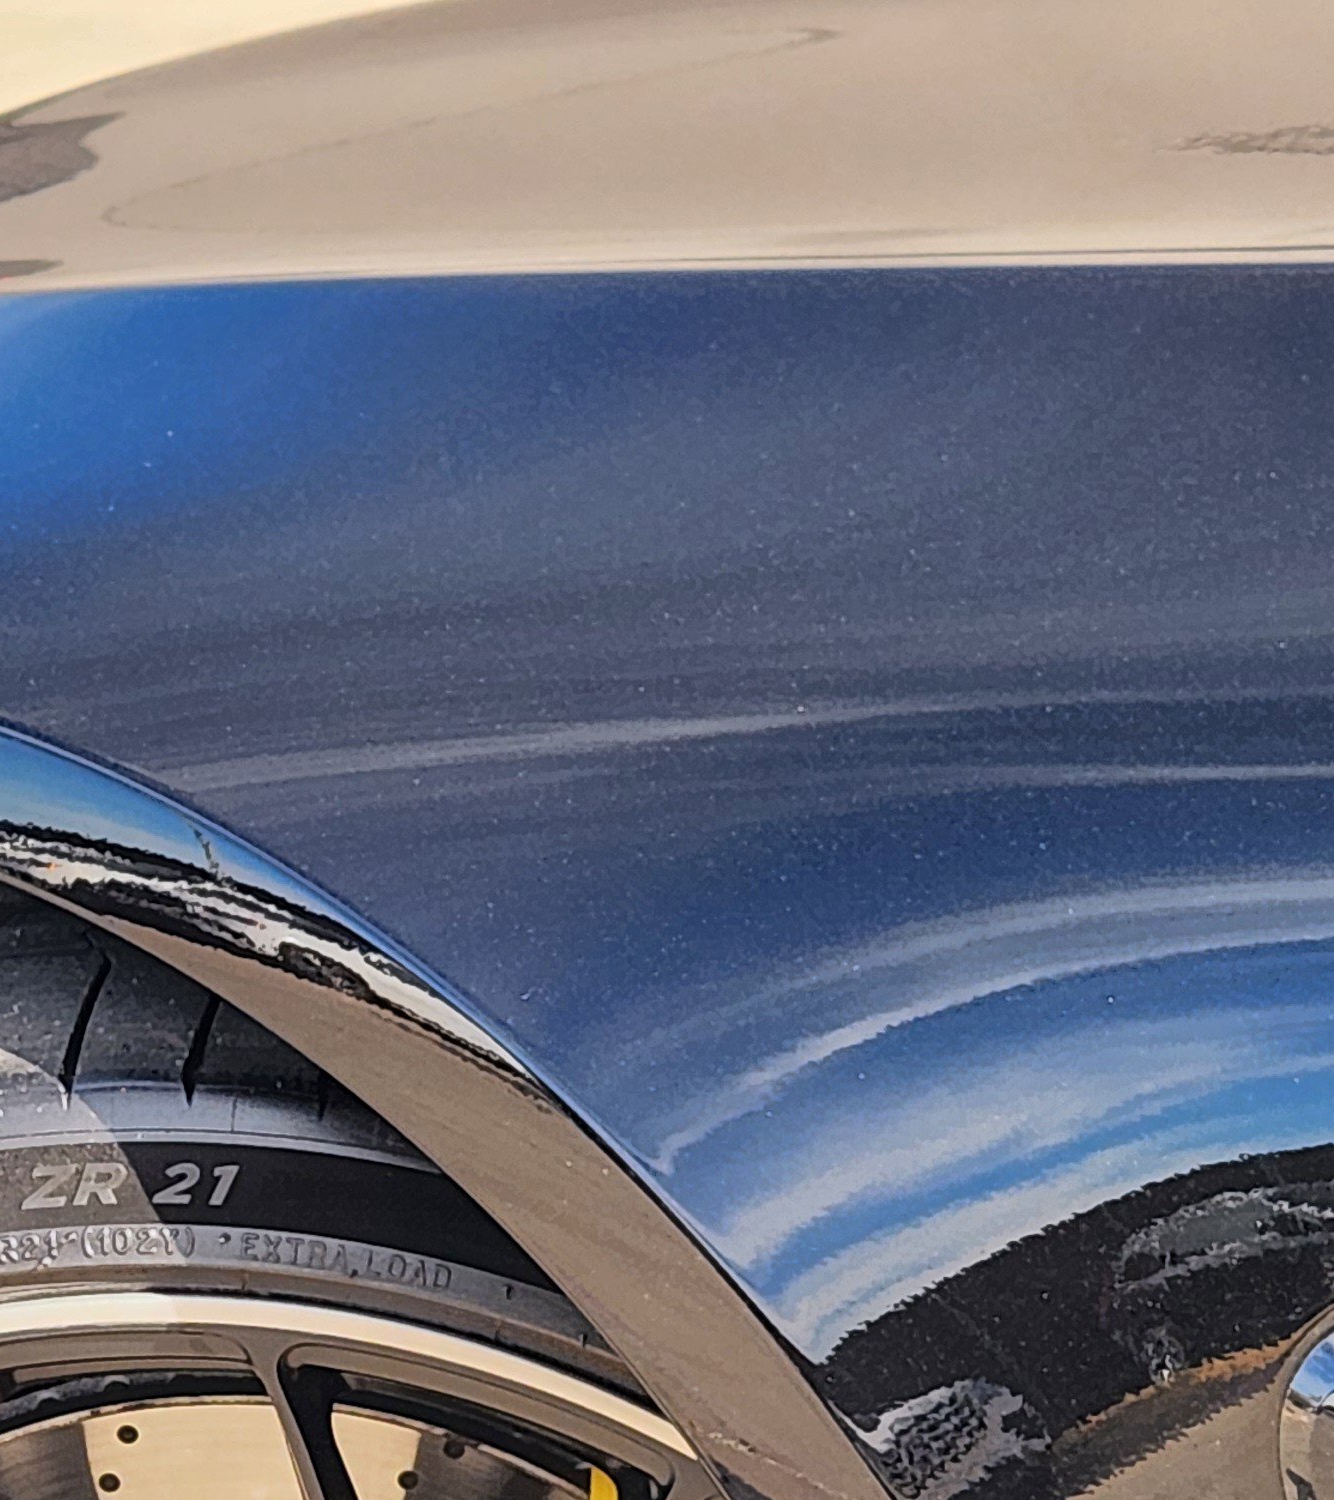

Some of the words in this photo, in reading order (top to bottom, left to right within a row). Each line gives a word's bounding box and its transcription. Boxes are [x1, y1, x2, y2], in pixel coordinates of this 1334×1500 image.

[20, 1161, 127, 1211] ZR
[151, 1163, 241, 1206] 21
[240, 1232, 352, 1273] EXTRA
[364, 1251, 453, 1289] LOAD
